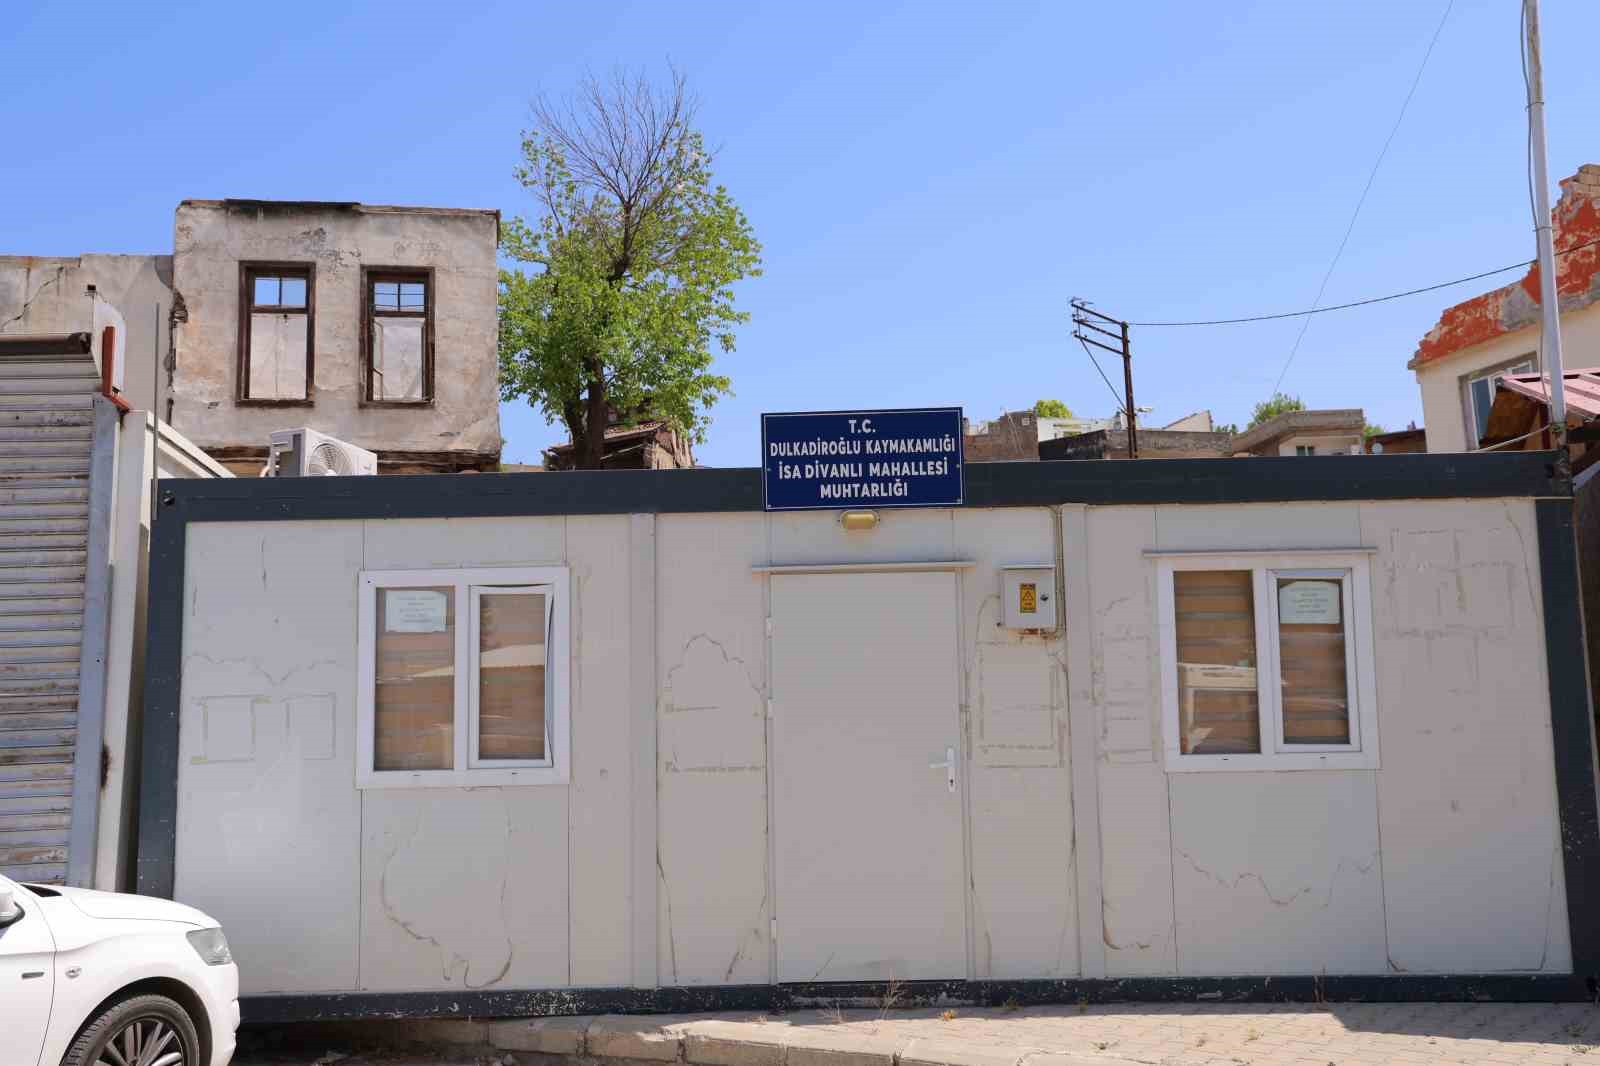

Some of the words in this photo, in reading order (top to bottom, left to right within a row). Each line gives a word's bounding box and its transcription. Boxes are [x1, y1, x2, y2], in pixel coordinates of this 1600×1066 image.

[848, 419, 876, 434] T.C.
[770, 437, 861, 457] DULKADİROĞLU
[866, 434, 955, 455] KAYMAKAMLIĞI
[779, 461, 802, 480] İSA
[805, 460, 863, 479] DİVANLI
[869, 457, 948, 477] MAHALLESİ
[820, 479, 908, 499] MUHTARLIĞI
